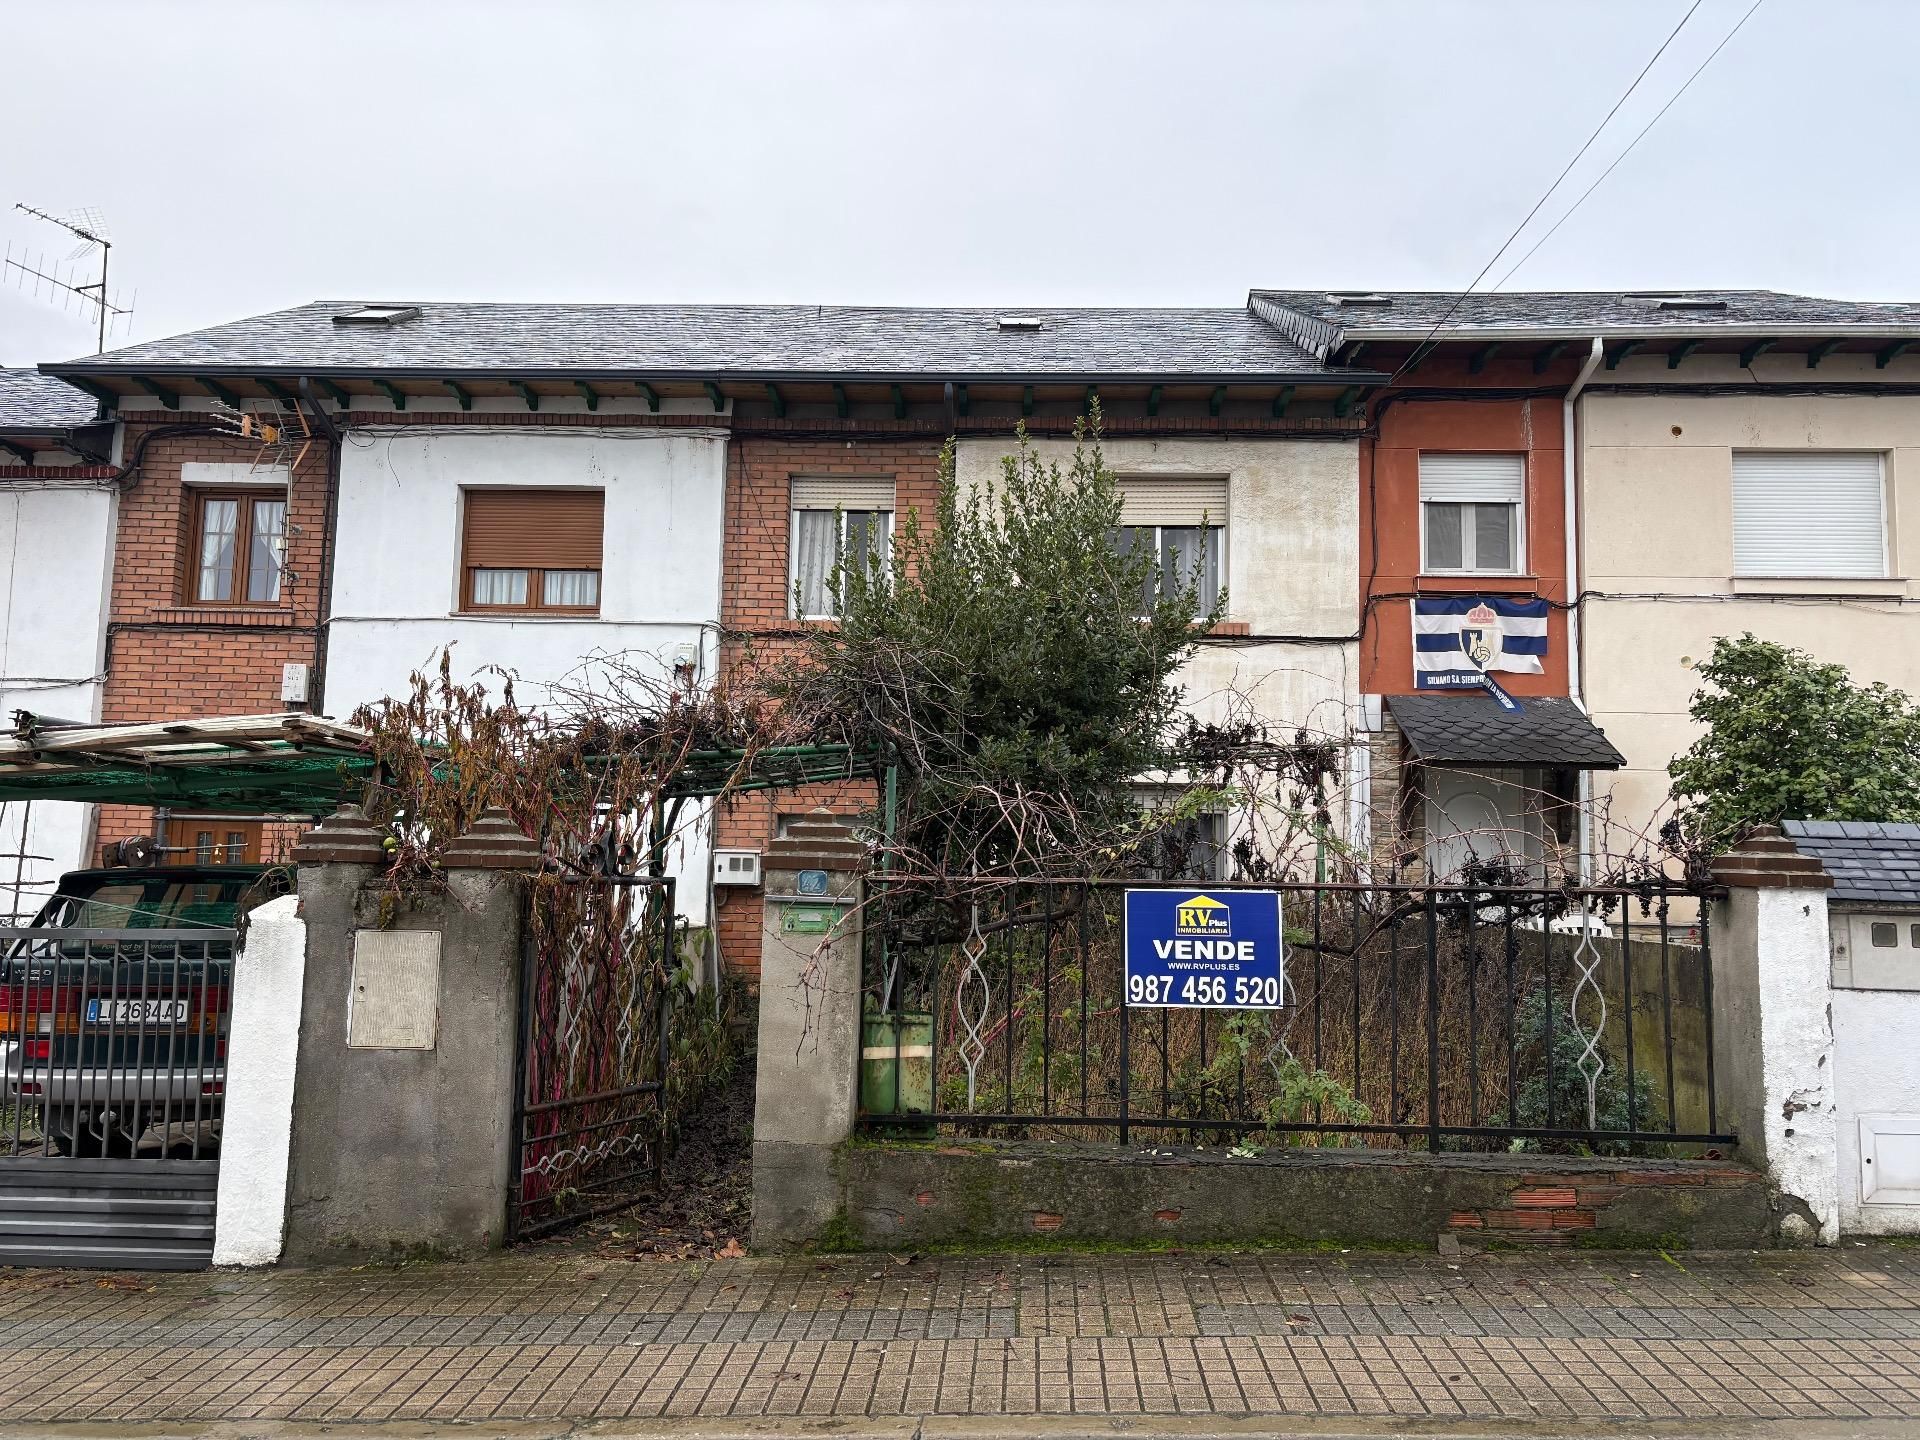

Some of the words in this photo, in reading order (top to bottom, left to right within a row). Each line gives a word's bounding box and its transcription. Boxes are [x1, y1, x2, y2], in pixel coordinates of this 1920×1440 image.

[1179, 909, 1212, 927] RV
[1208, 919, 1228, 927] Plus
[1153, 940, 1255, 961] VENDE
[1168, 962, 1240, 971] WWW.RVPLUS.ES
[1130, 975, 1174, 1003] 987
[1181, 975, 1226, 1004] 456
[1235, 977, 1278, 1005] 520
